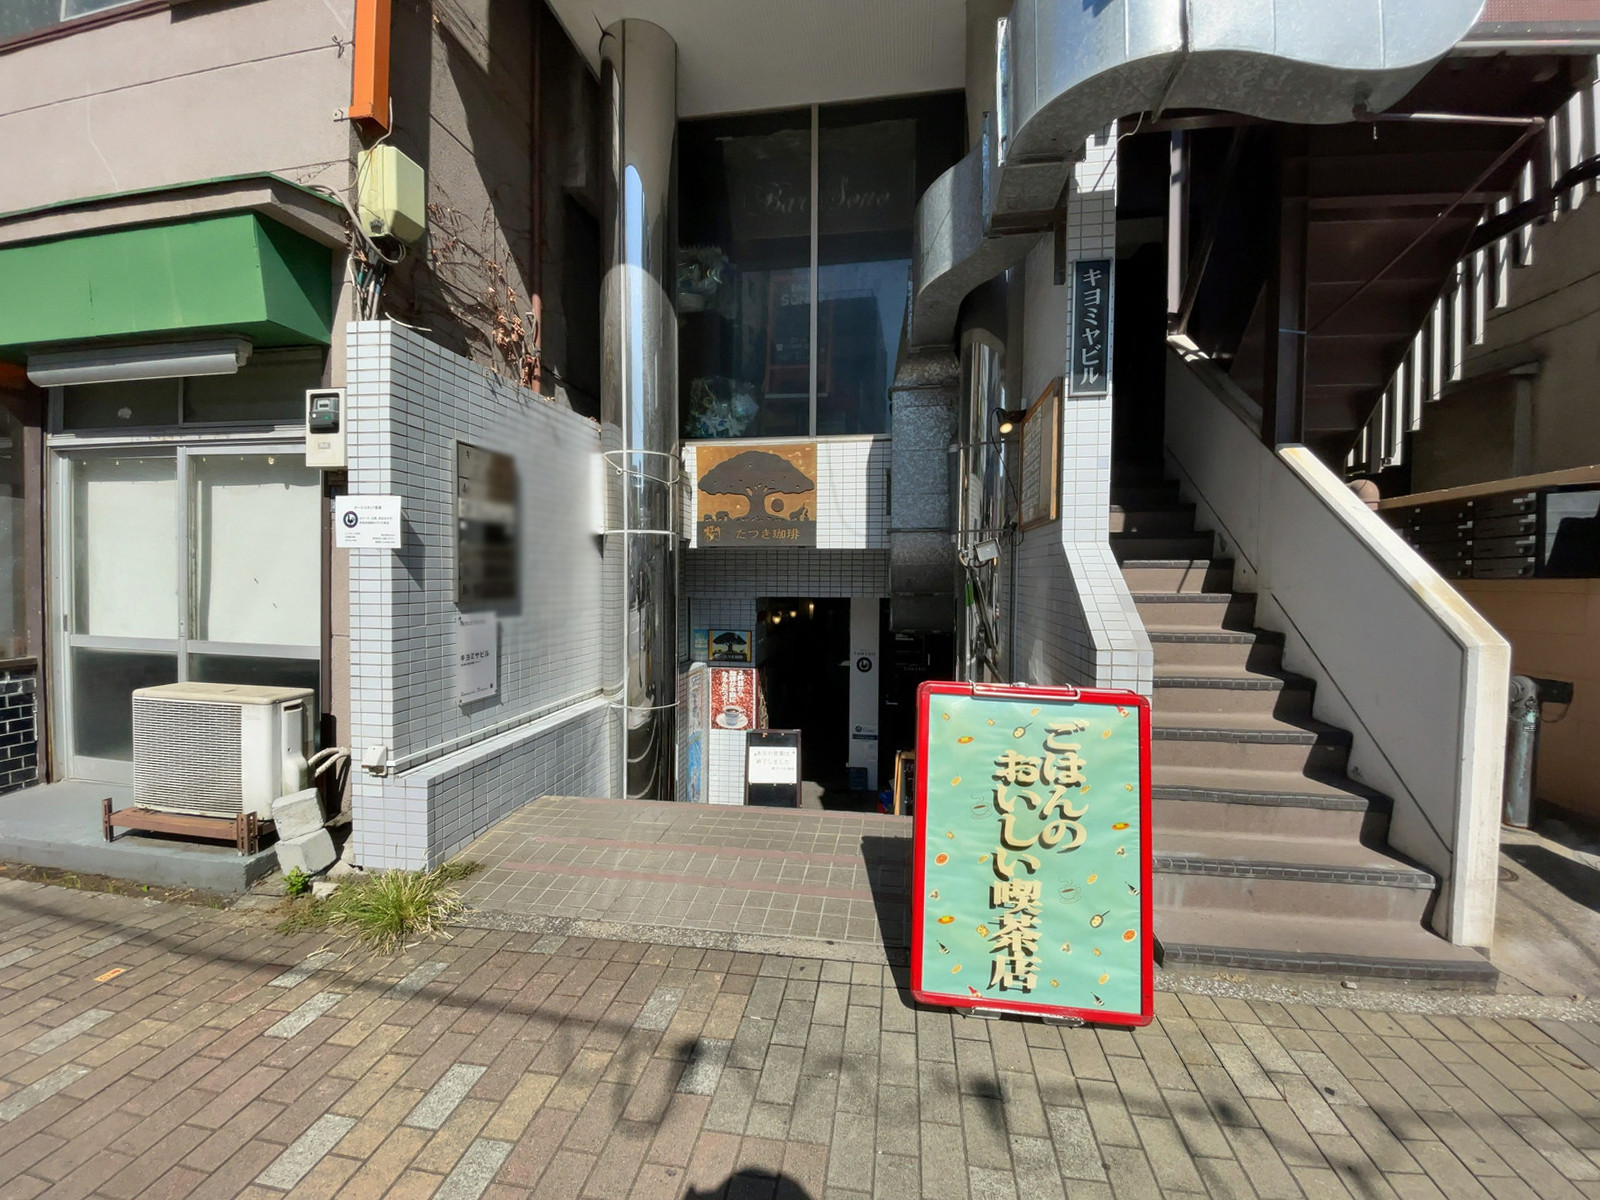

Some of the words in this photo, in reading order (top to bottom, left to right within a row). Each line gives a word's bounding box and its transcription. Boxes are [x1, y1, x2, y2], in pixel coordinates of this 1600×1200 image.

[1080, 268, 1102, 386] キヨミヤビル
[736, 528, 801, 540] たつき珈琲
[1039, 720, 1090, 853] ごはんの
[988, 750, 1043, 993] おいしい喫茶店
